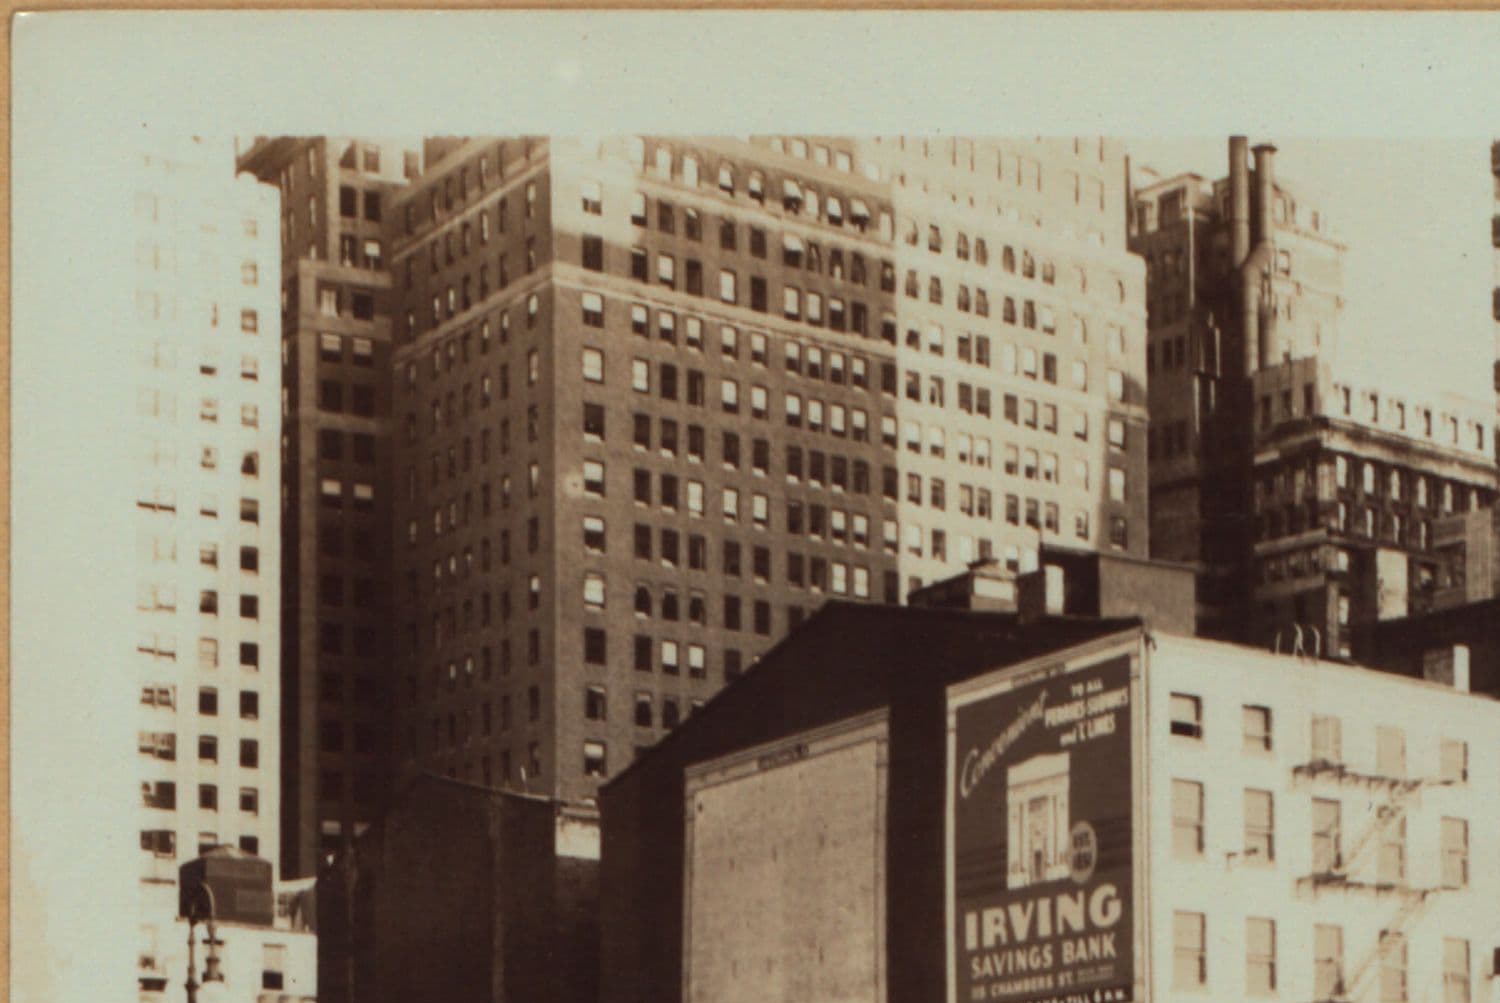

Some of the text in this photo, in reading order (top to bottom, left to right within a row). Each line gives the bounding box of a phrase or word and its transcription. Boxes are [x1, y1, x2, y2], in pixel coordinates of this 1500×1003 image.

[965, 884, 1122, 951] IRVING
[971, 945, 1053, 979] SAVINGS
[1062, 932, 1117, 964] BANK
[991, 974, 1053, 997] CHAMBERS
